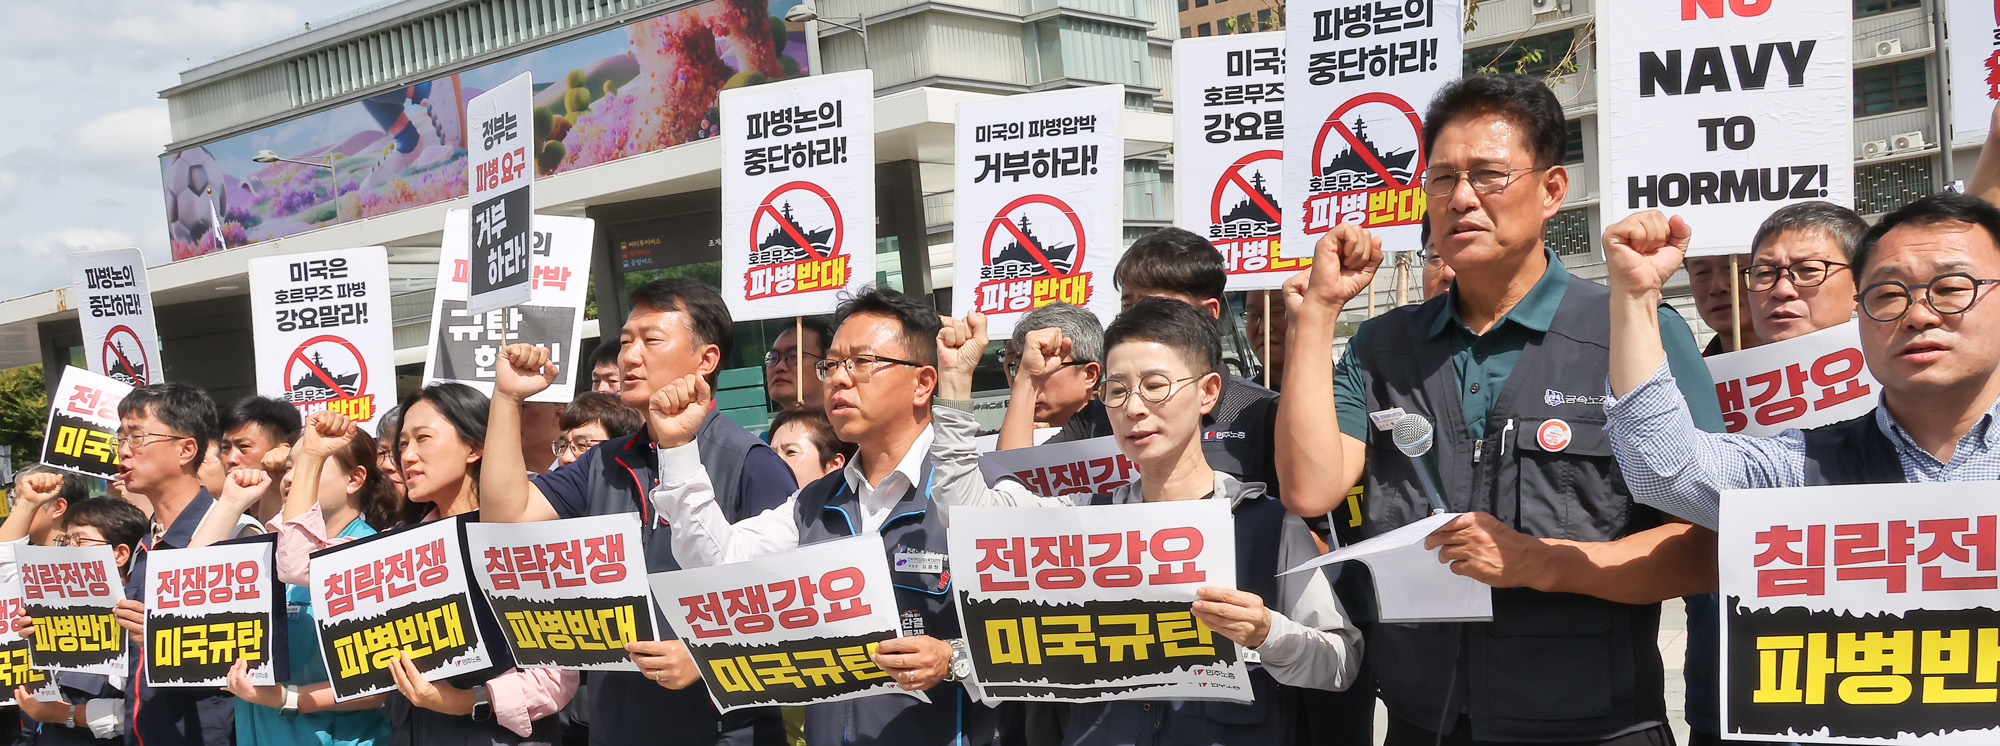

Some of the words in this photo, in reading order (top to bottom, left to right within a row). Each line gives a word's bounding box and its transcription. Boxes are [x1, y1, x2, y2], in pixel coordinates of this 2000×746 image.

[1312, 0, 1434, 42] 파병논의
[1227, 47, 1286, 77] 미국
[1308, 38, 1438, 86] 중단하라!
[1639, 39, 1817, 98] NAVY
[1203, 82, 1284, 107] 호르무즈
[482, 111, 517, 151] 정부는
[746, 100, 843, 140] 파병논의
[975, 121, 1024, 143] 미국의
[1028, 114, 1097, 138] 파병압박
[1698, 115, 1756, 152] TO
[476, 162, 499, 193] 파병
[501, 147, 526, 184] 요구
[744, 136, 847, 177] 중단하라!
[974, 144, 1098, 184] 거부하라!
[1308, 173, 1368, 193] 호르무즈
[1627, 164, 1829, 209] HORMUZ!
[475, 199, 508, 249] 거부
[1309, 186, 1427, 230] 파병반대
[1209, 222, 1267, 238] 호르무즈
[85, 264, 136, 290] 파병논의
[289, 257, 348, 282] 미국은
[487, 231, 527, 286] 하라!
[748, 249, 796, 265] 호르무즈
[749, 257, 846, 297] 파병반대
[980, 262, 1032, 280] 호르무즈
[89, 293, 142, 318] 중단하라!
[274, 287, 333, 305] 호르무즈
[336, 282, 366, 299] 파병
[980, 274, 1087, 312] 파병반대
[275, 302, 368, 332] 강요말라!
[449, 308, 523, 342] 규탄
[284, 388, 326, 402] 호르무즈
[324, 538, 449, 618] 침략전쟁
[483, 533, 627, 591] 침략전쟁
[975, 526, 1206, 592] 전쟁강요
[22, 560, 110, 599] 침략전쟁
[157, 560, 260, 609] 전쟁강요
[678, 566, 872, 639] 전쟁강요
[32, 613, 121, 652] 파병반대
[155, 619, 263, 667] 미국규탄
[333, 602, 465, 679] 파병반대
[504, 605, 637, 651] 파병반대
[984, 611, 1216, 665] 미국규탄
